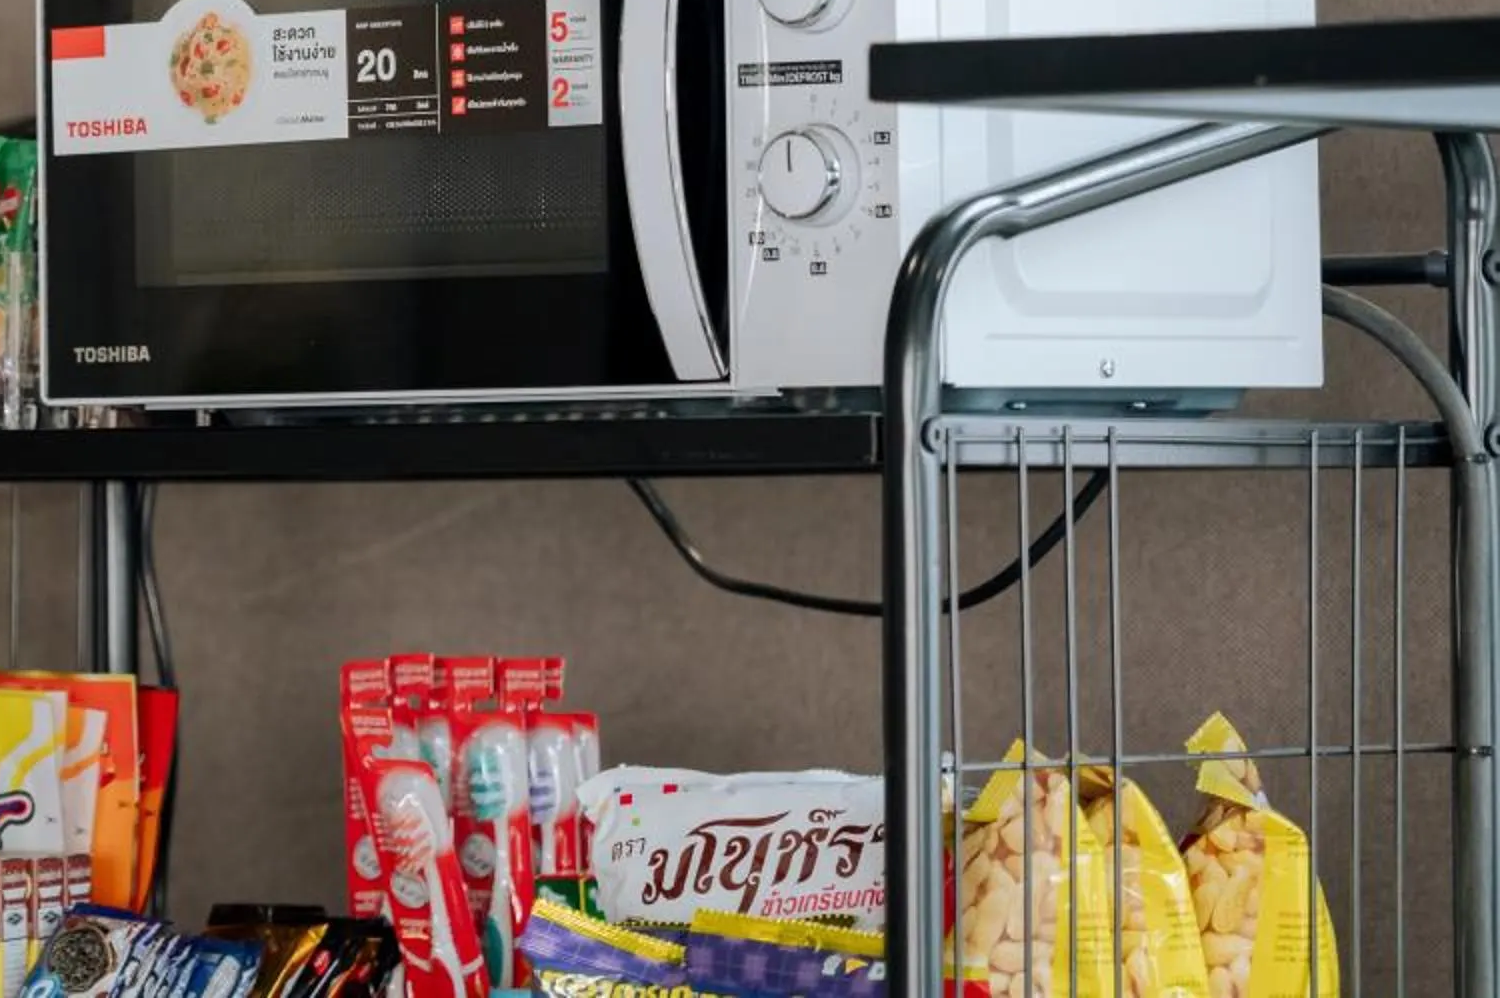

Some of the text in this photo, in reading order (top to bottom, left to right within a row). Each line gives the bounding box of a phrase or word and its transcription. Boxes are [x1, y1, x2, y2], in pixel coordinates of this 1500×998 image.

[272, 26, 316, 41] สะดวก
[551, 12, 568, 43] 5
[272, 42, 336, 62] ใช้งานง่าย
[356, 47, 397, 84] 20
[552, 77, 570, 108] 2
[67, 118, 148, 139] TOSHIBA
[73, 345, 152, 363] TOSHIBA
[611, 836, 647, 862] ตรา
